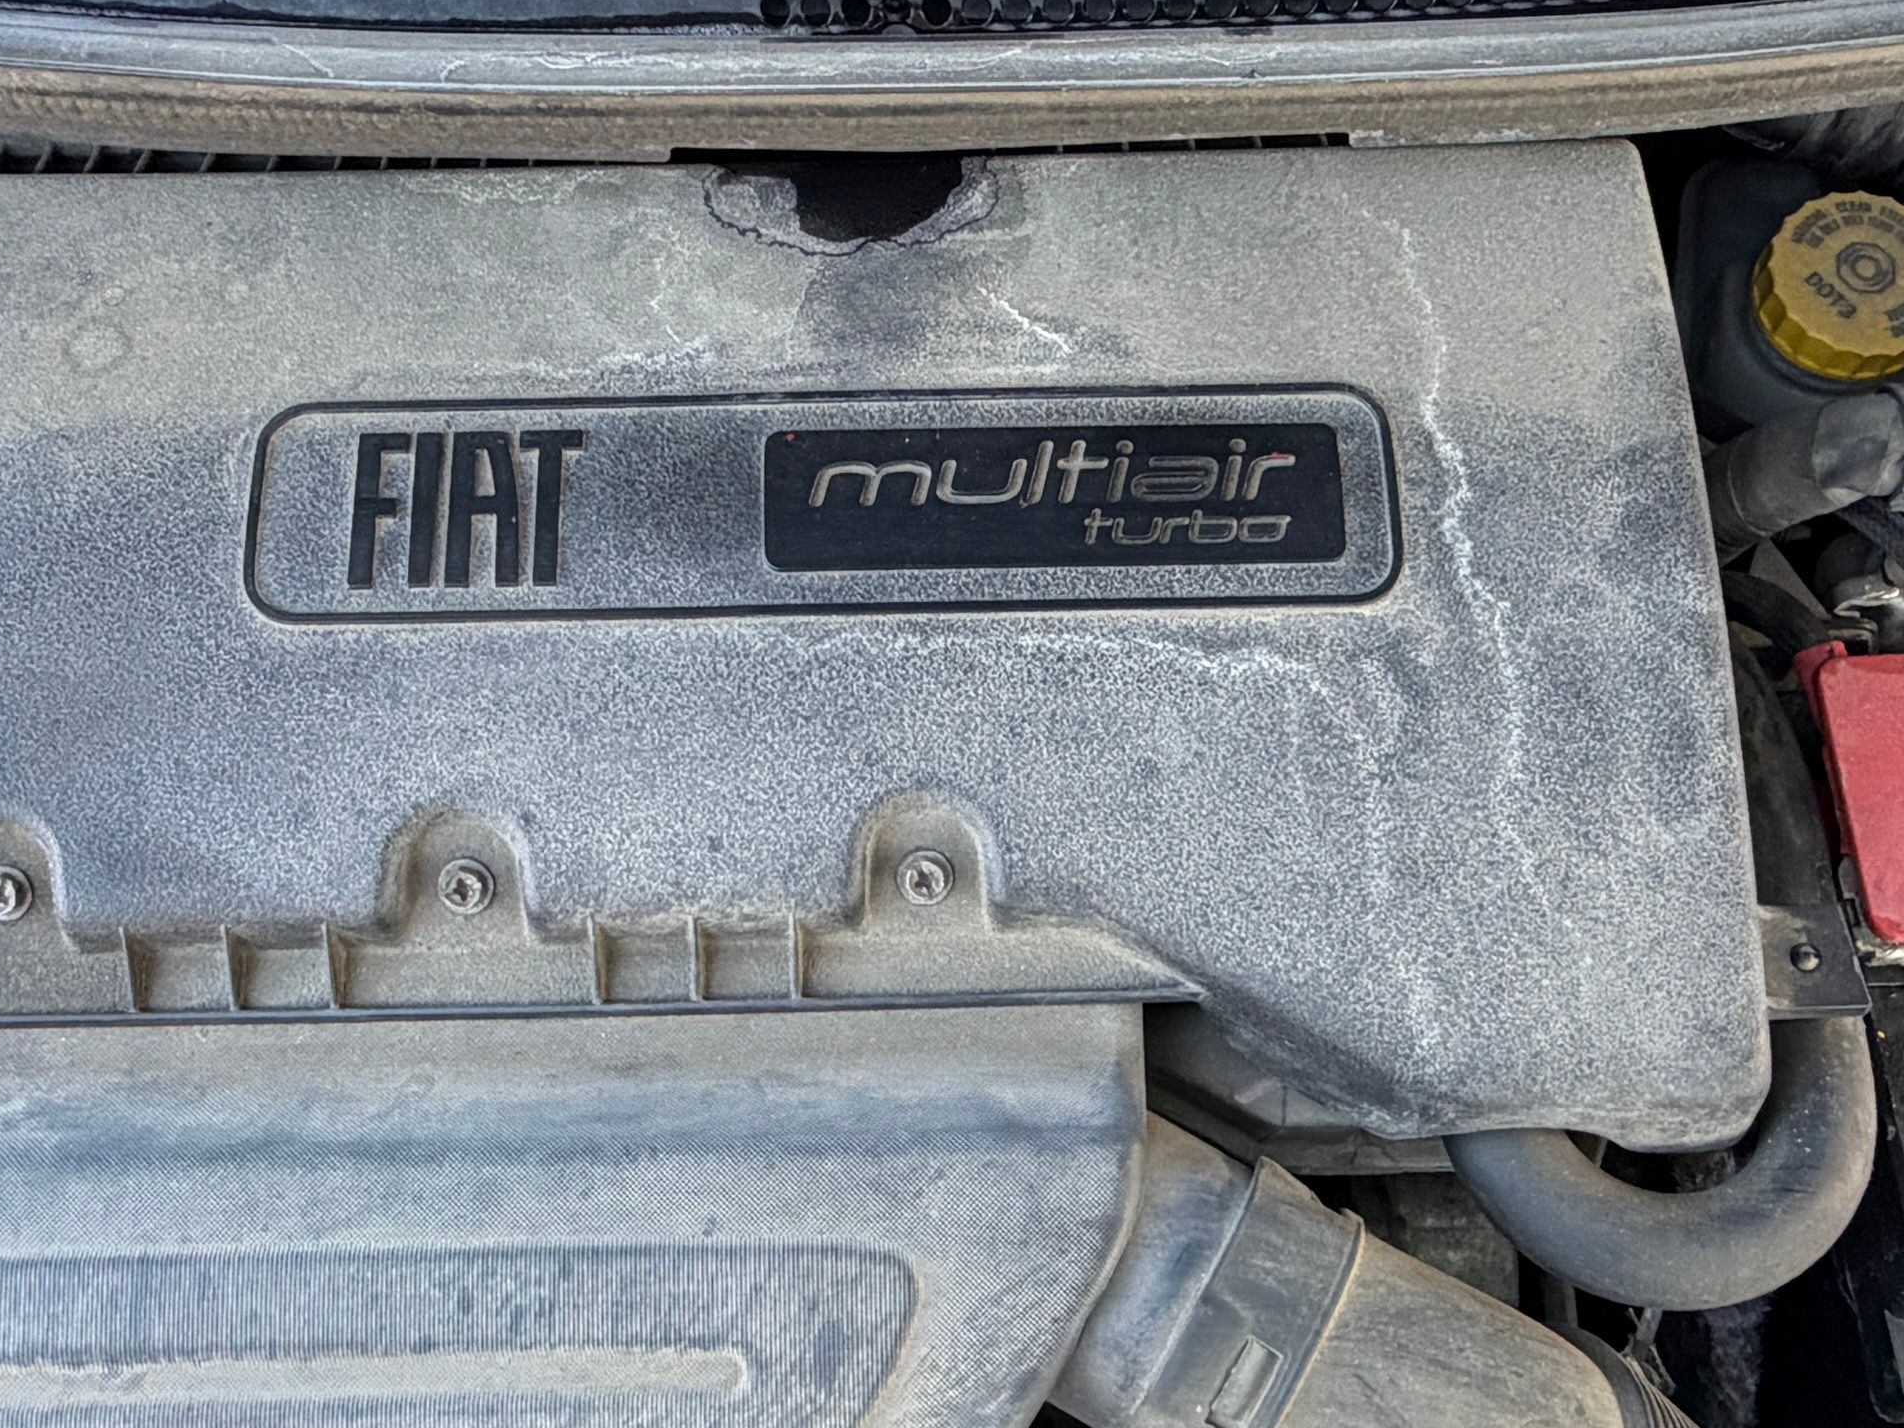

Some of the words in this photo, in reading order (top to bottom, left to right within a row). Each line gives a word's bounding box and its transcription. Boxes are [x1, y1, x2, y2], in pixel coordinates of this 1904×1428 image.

[344, 429, 587, 591] FIAT
[807, 436, 1302, 510] multiair
[1081, 506, 1291, 548] turbo
